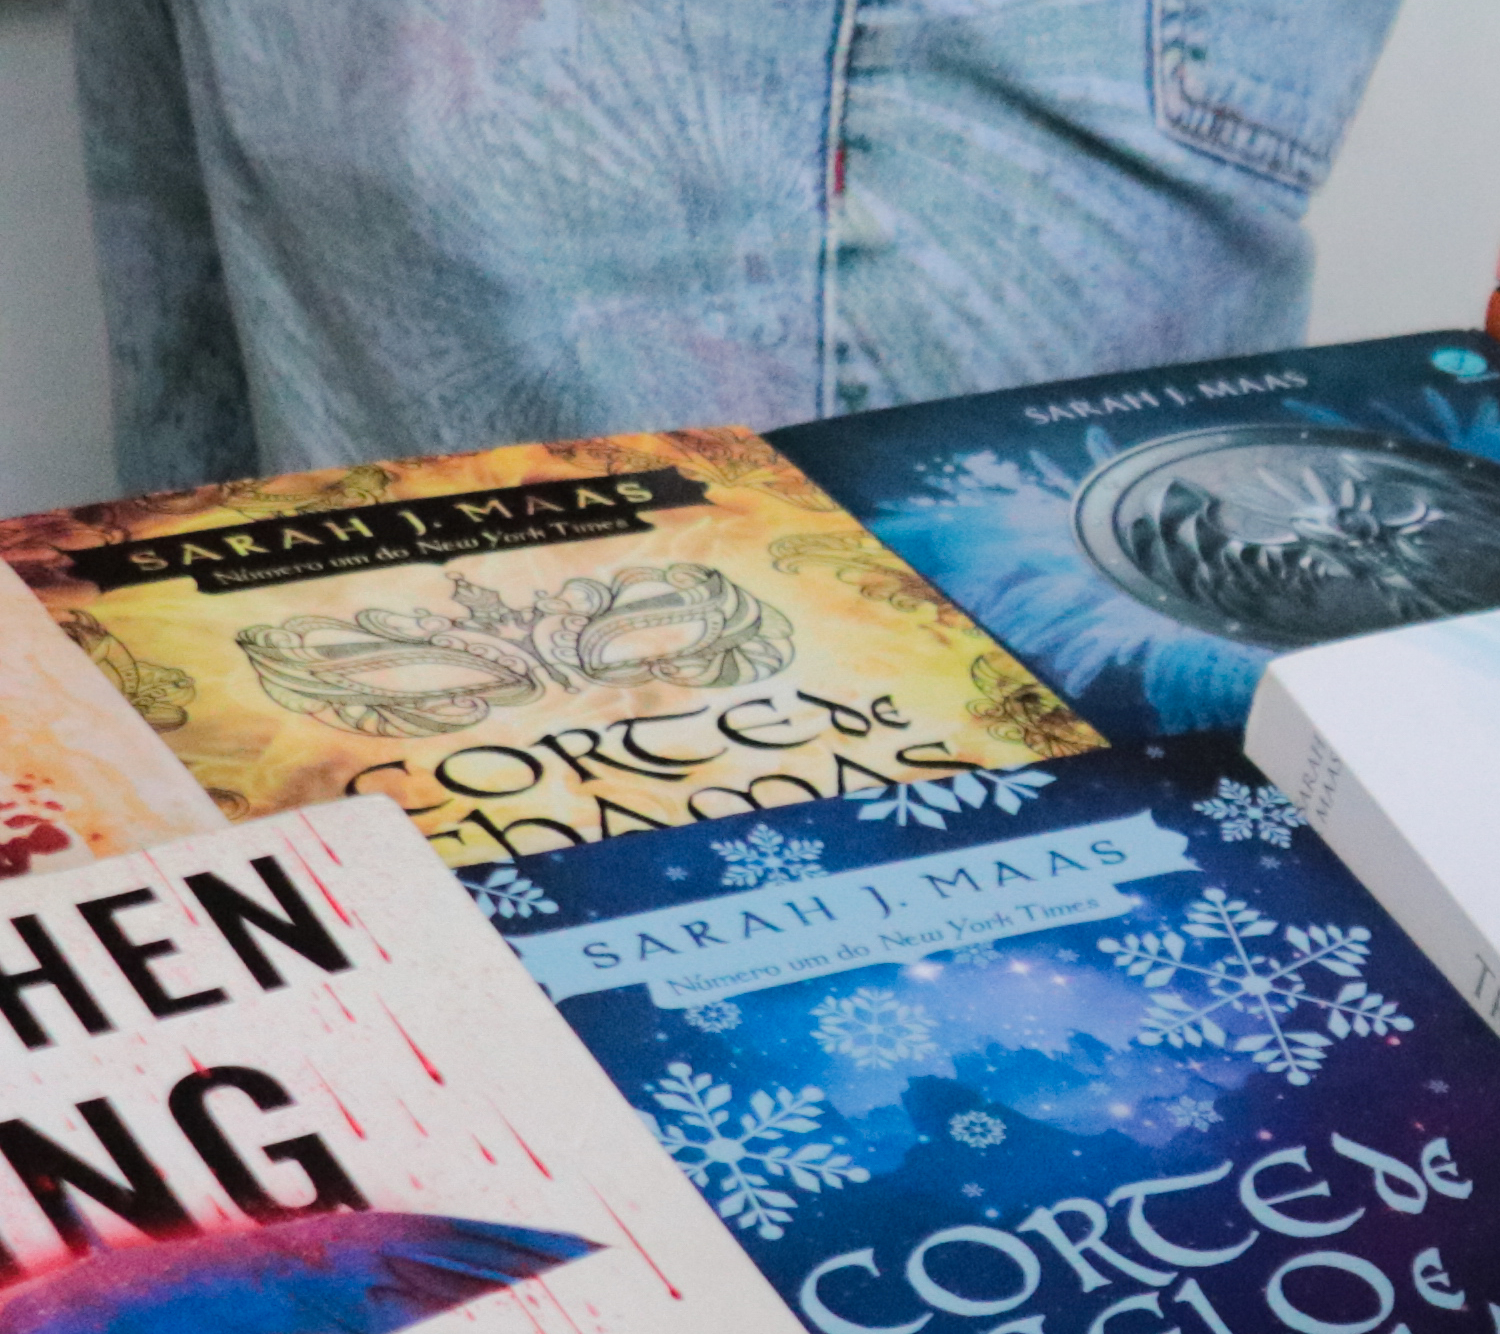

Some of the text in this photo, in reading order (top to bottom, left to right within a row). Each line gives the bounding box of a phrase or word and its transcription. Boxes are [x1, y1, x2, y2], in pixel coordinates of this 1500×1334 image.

[1023, 368, 1309, 428] SARAH J. MAAS
[129, 480, 656, 572] SARAH J. MAAS
[213, 517, 631, 587] Número um do New York Times
[584, 836, 1129, 971] SARAH J. MAAS
[670, 894, 1102, 997] Número um do New York Times
[0, 1064, 373, 1268] NG
